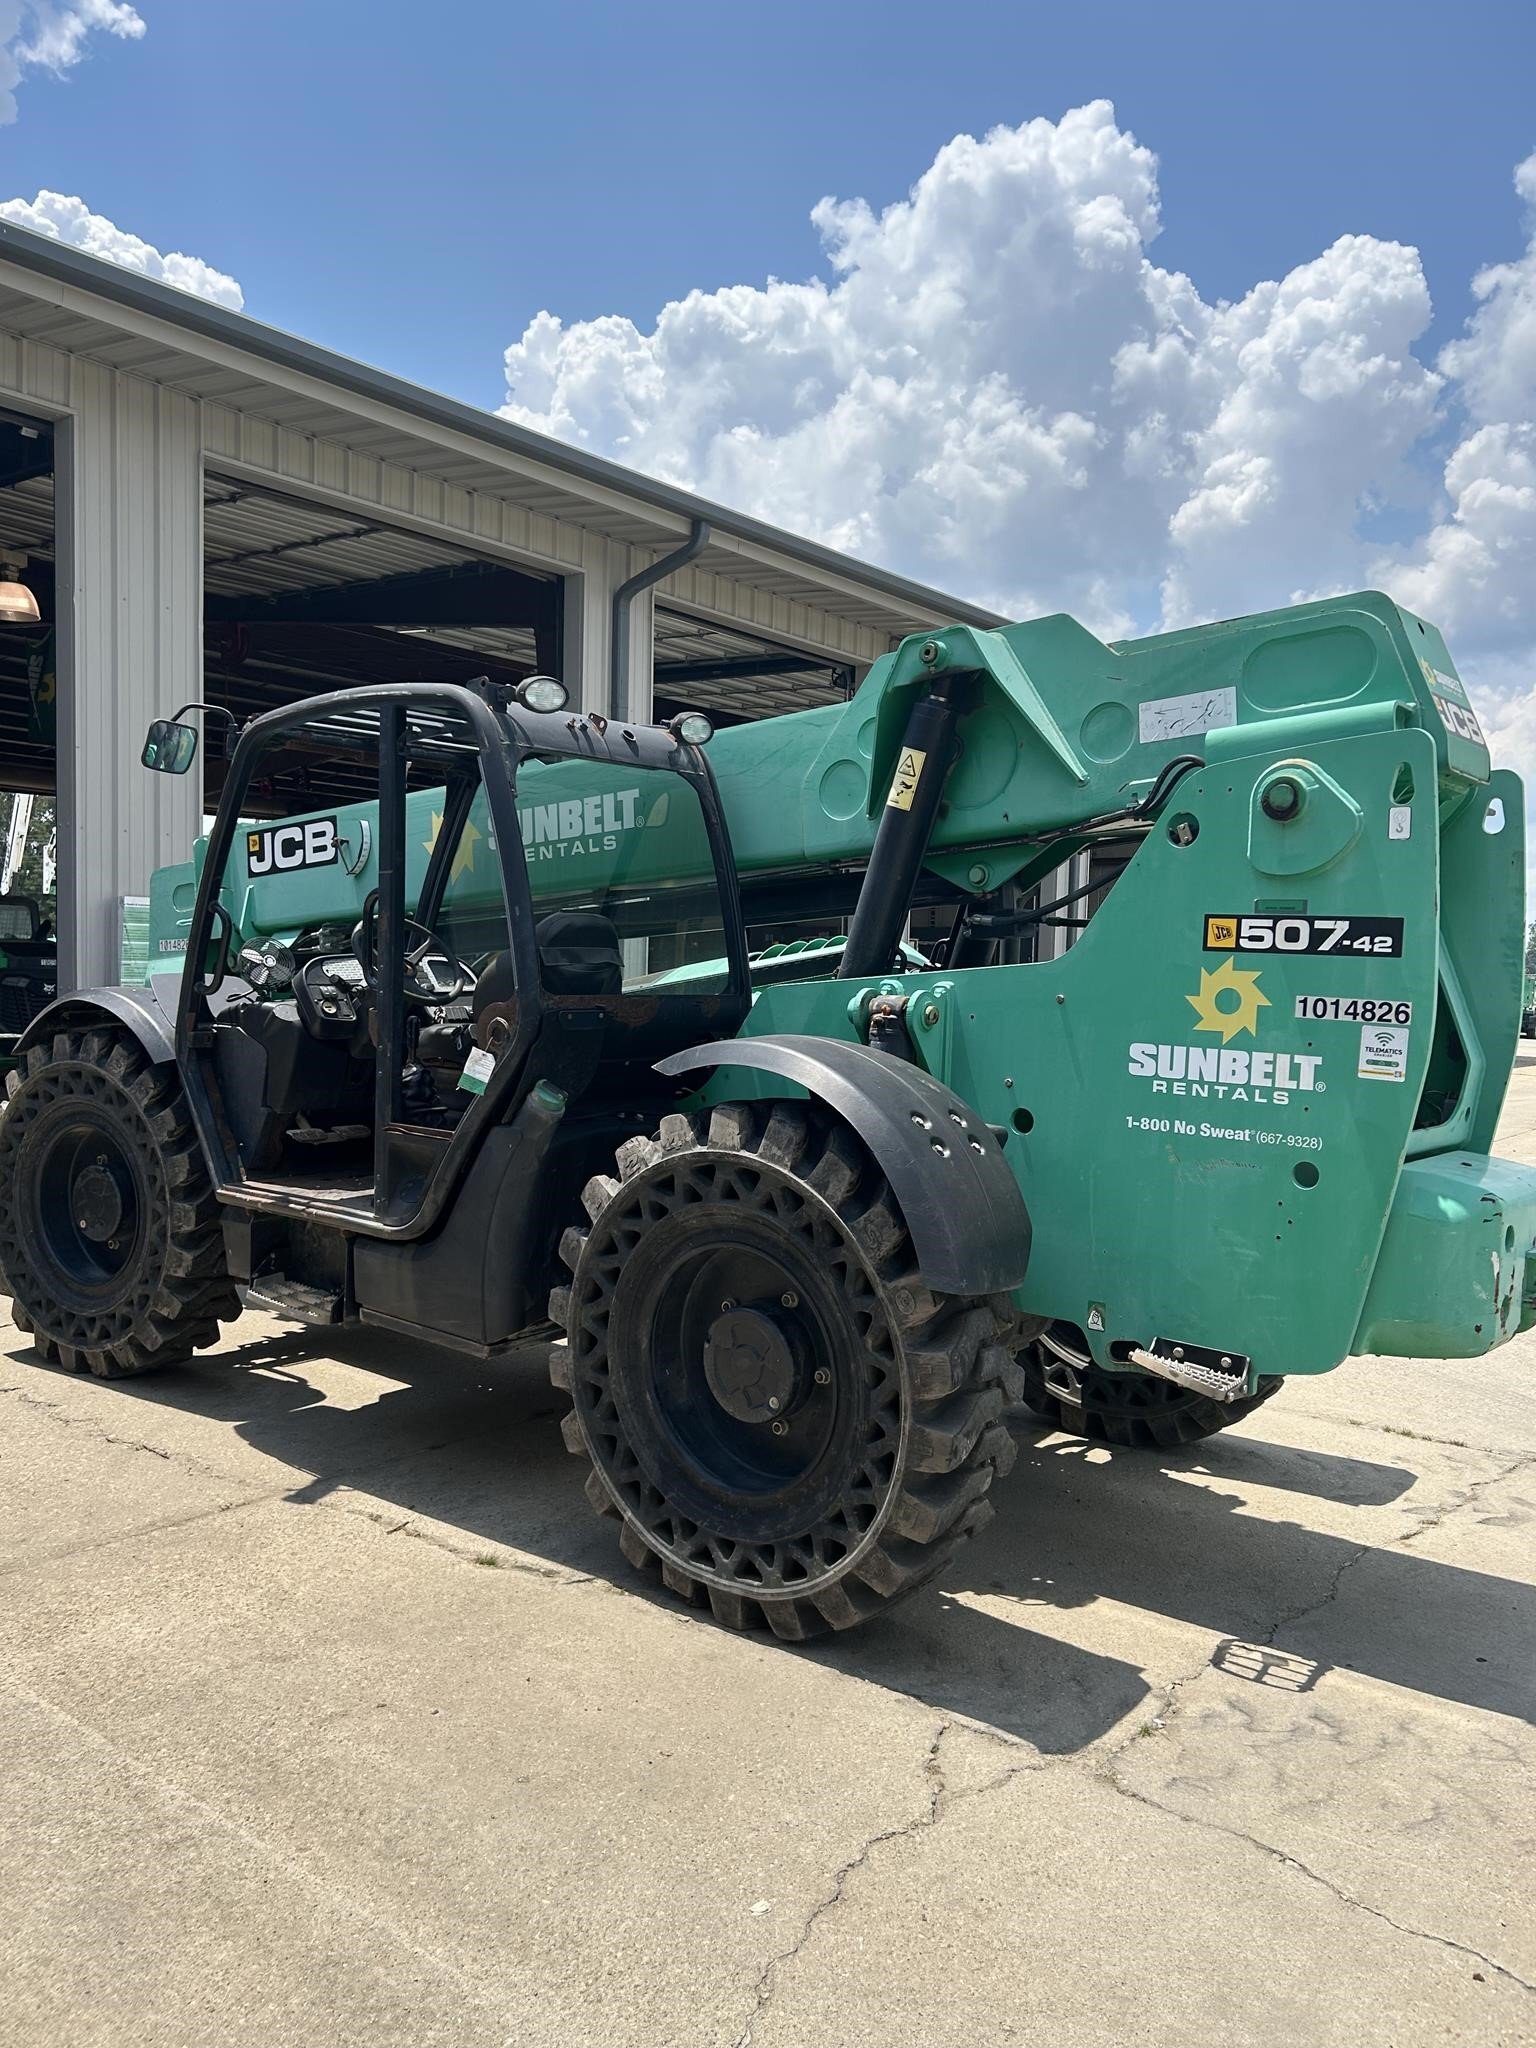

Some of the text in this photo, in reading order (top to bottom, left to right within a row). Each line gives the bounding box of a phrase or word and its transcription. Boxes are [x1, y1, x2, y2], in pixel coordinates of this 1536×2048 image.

[249, 821, 336, 873] JCB
[525, 835, 617, 862] ENTALS
[1214, 918, 1394, 953] JCB 507-42
[1297, 996, 1411, 1024] 1014826
[1128, 1042, 1323, 1091] SUNBELT
[1365, 1046, 1403, 1056] TELEMATICS
[1152, 1080, 1289, 1105] RENTALS
[1125, 1116, 1324, 1151] 1-800 No Sweat (667-9328)
